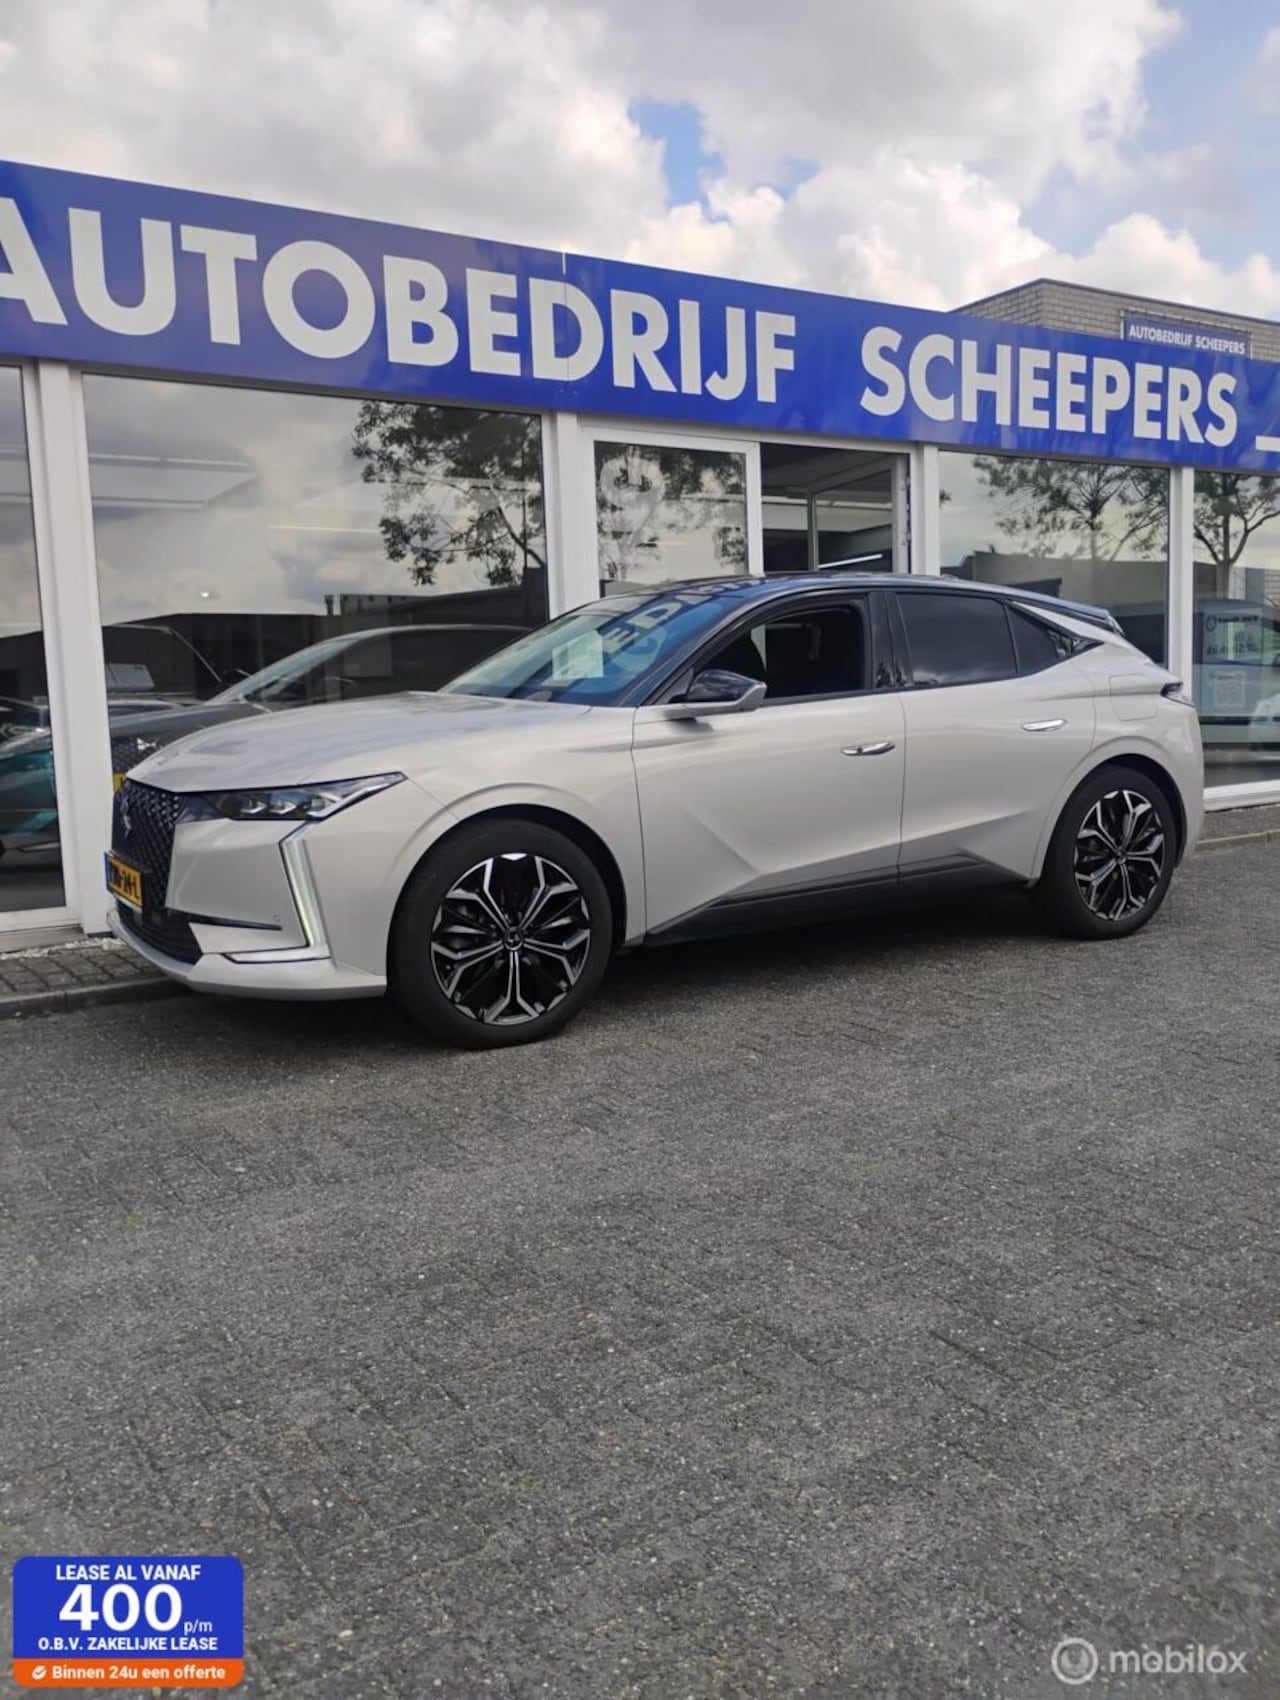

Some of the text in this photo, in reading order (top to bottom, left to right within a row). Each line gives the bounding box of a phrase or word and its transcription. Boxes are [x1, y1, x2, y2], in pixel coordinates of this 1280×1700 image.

[0, 197, 1238, 447] AUTOBEDRIJF SCHEEPERS
[1129, 324, 1246, 355] AUTOBEDRIJF SCHEEPERS
